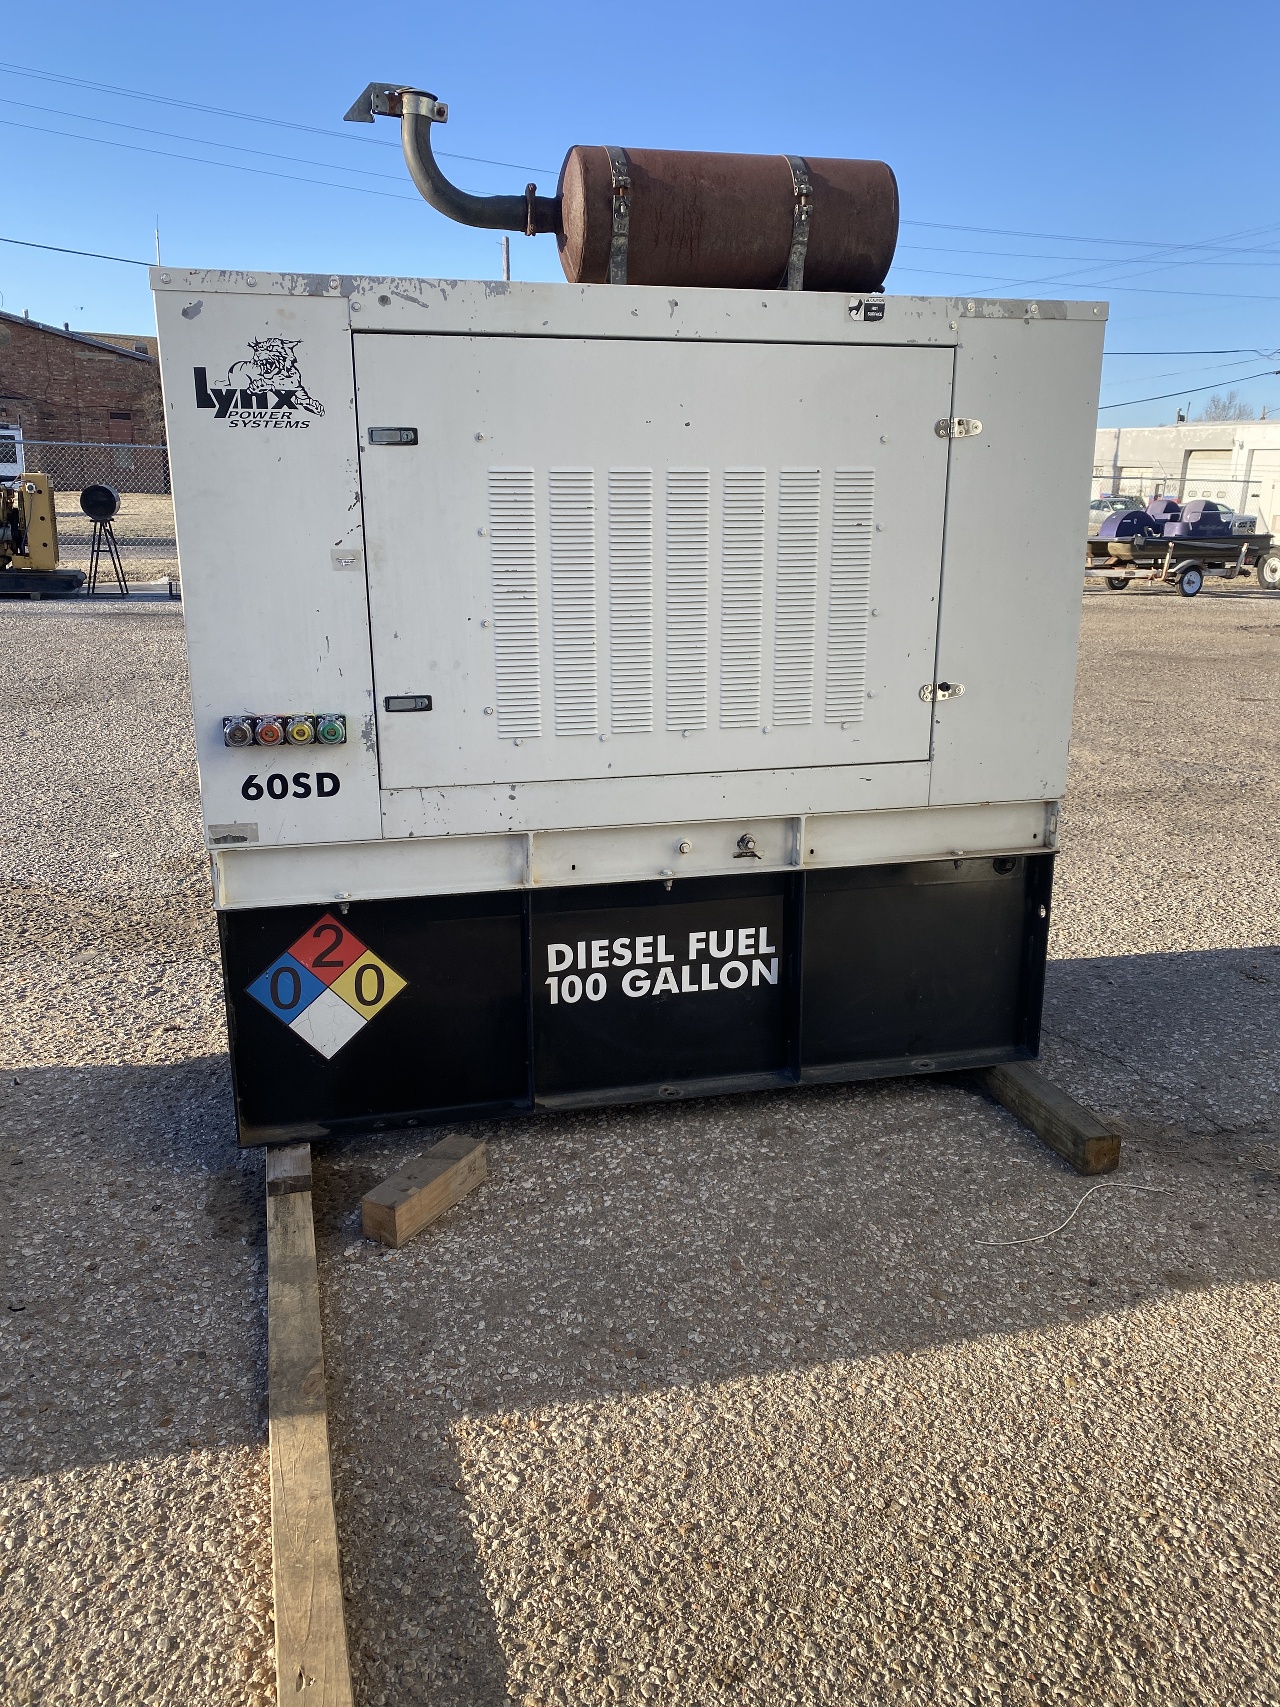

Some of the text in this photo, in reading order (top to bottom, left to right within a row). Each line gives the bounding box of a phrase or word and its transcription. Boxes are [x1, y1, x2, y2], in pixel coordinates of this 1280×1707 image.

[193, 366, 299, 418] Lynx
[227, 411, 293, 420] POWER
[228, 420, 311, 429] SYSTEMS
[241, 772, 341, 801] 60SD
[311, 923, 344, 968] 2
[547, 926, 776, 973] DIESEL FUEL
[269, 966, 302, 1010] 0
[354, 963, 385, 1007] 0
[544, 957, 779, 1005] 100 GALLON
